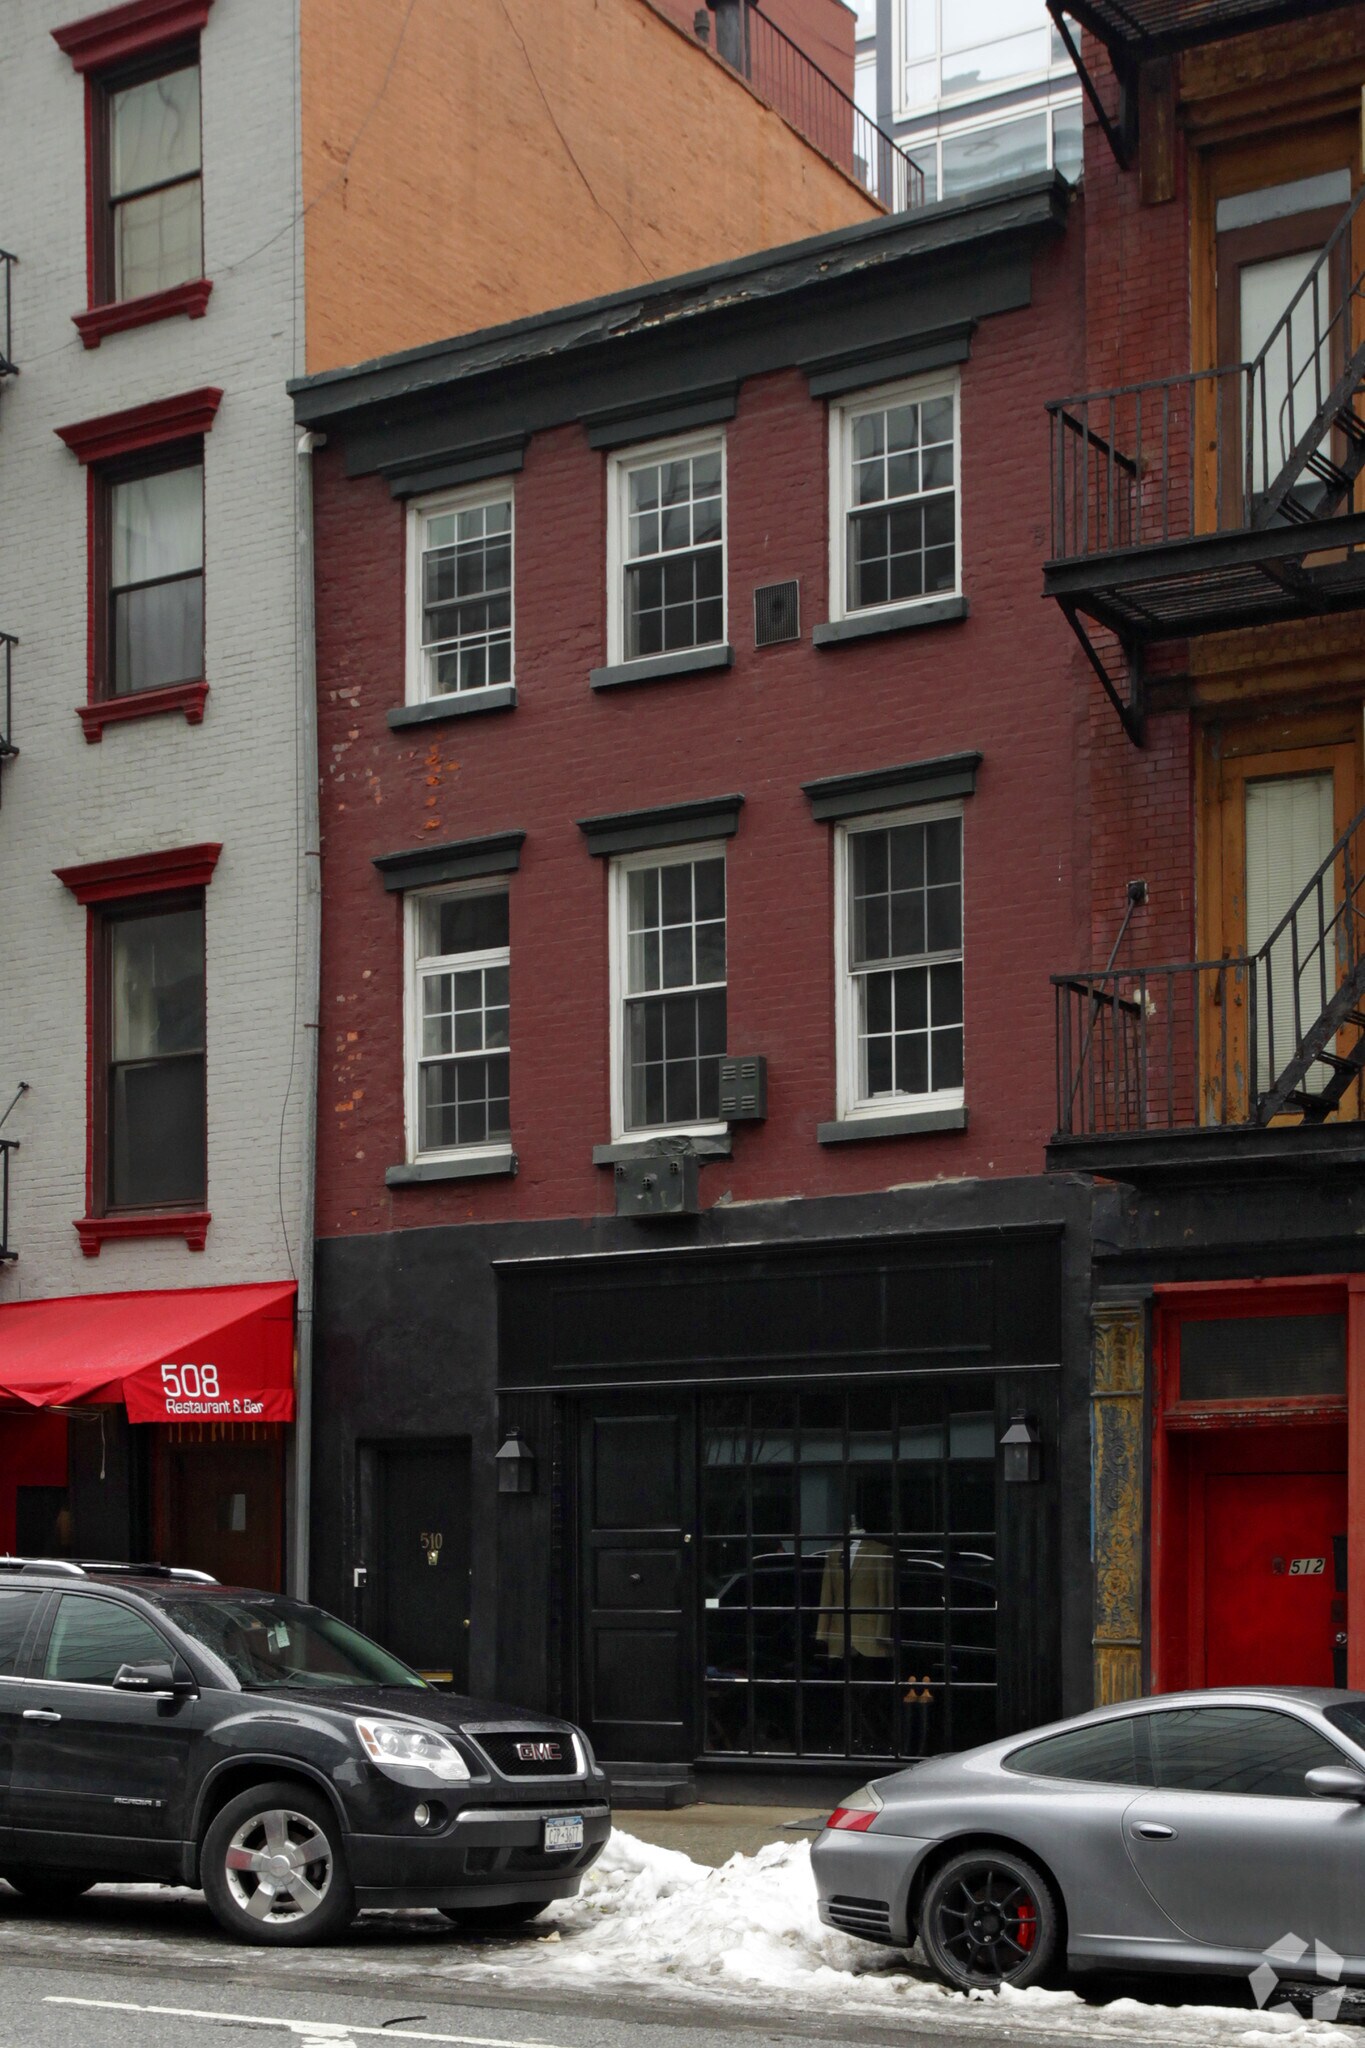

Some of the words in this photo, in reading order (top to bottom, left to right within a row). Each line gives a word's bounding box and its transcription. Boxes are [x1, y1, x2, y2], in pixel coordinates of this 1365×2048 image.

[161, 1364, 220, 1398] 508
[165, 1398, 231, 1414] Restaurant
[233, 1399, 241, 1414] &
[243, 1398, 264, 1414] Bar
[420, 1532, 443, 1550] 510
[1290, 1559, 1324, 1574] 512
[516, 1743, 561, 1760] GMC
